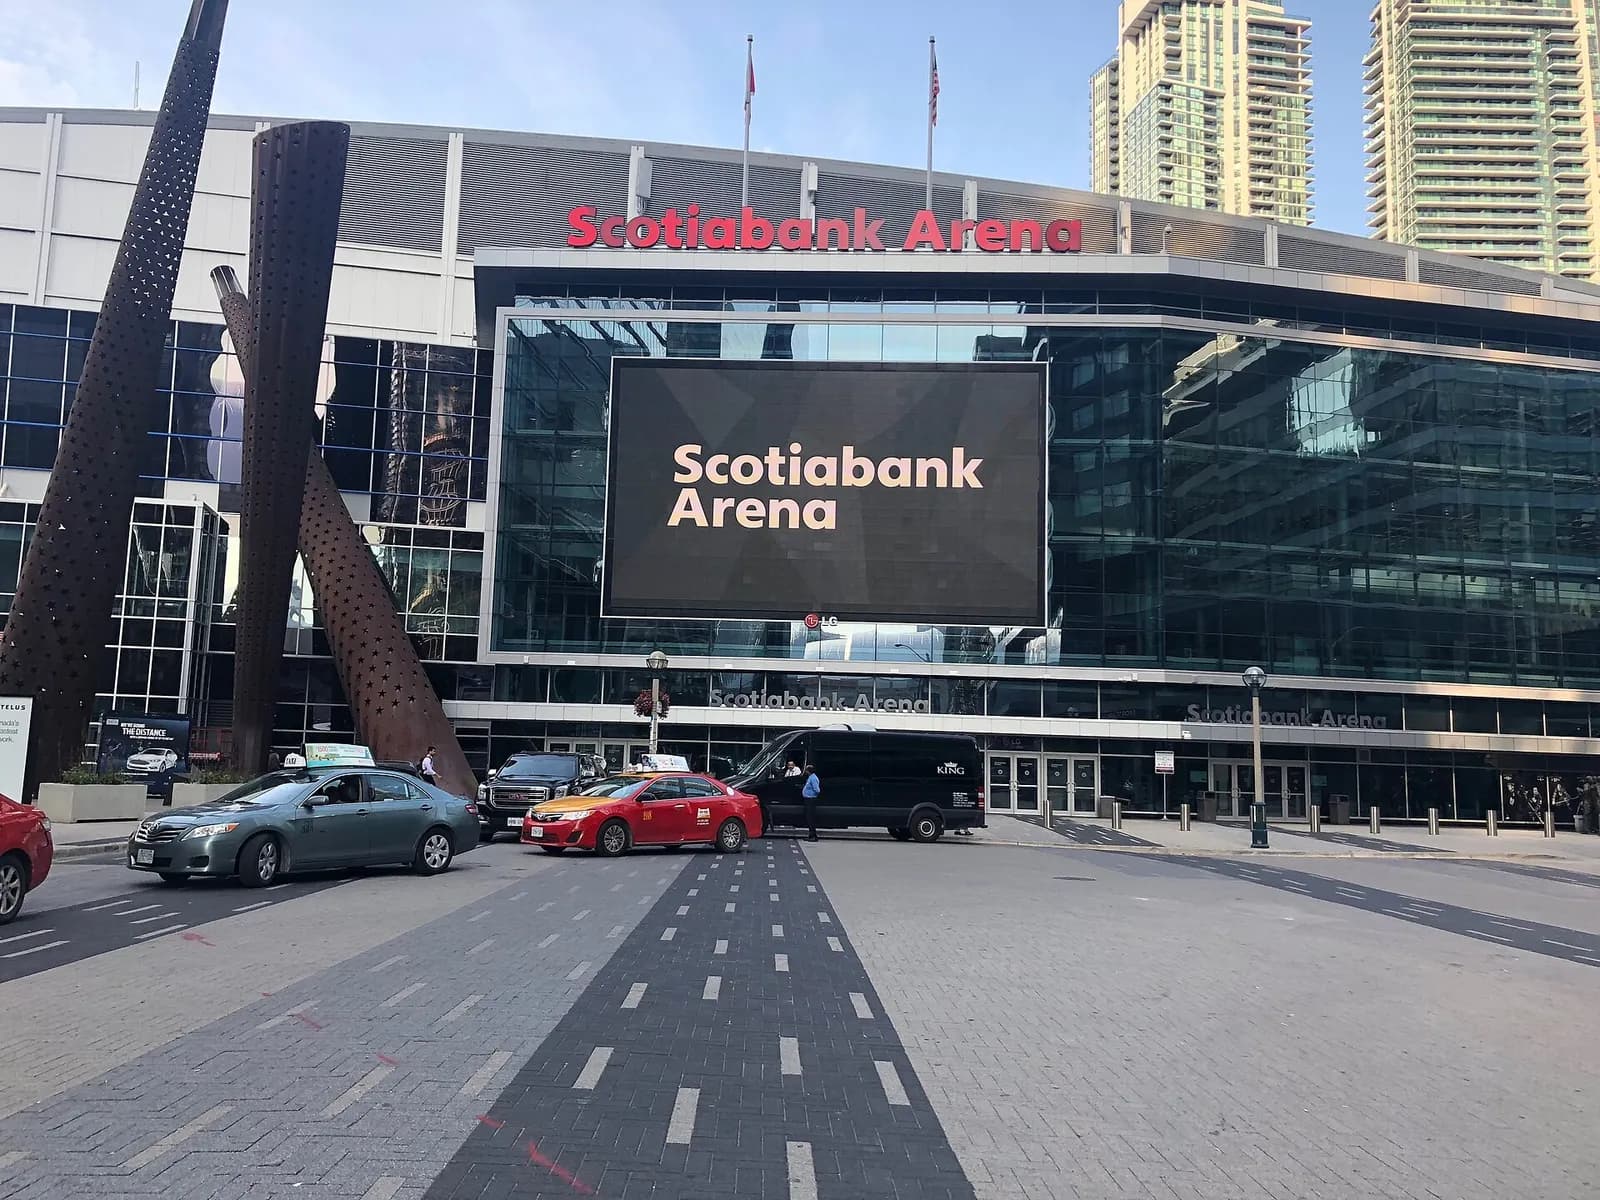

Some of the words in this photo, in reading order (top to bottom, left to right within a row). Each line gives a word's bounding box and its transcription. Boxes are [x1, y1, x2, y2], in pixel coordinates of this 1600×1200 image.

[566, 203, 885, 251] Scotiabank
[902, 208, 1083, 253] Arena
[672, 442, 984, 489] Scotiabank
[667, 487, 838, 530] Arena
[821, 616, 838, 626] LG
[710, 688, 847, 711] Scotiabank
[853, 692, 930, 713] Arena
[1186, 703, 1313, 726] Scotiabank
[1320, 708, 1387, 728] Arena
[136, 729, 167, 737] DISTANCE
[937, 766, 965, 775] KING
